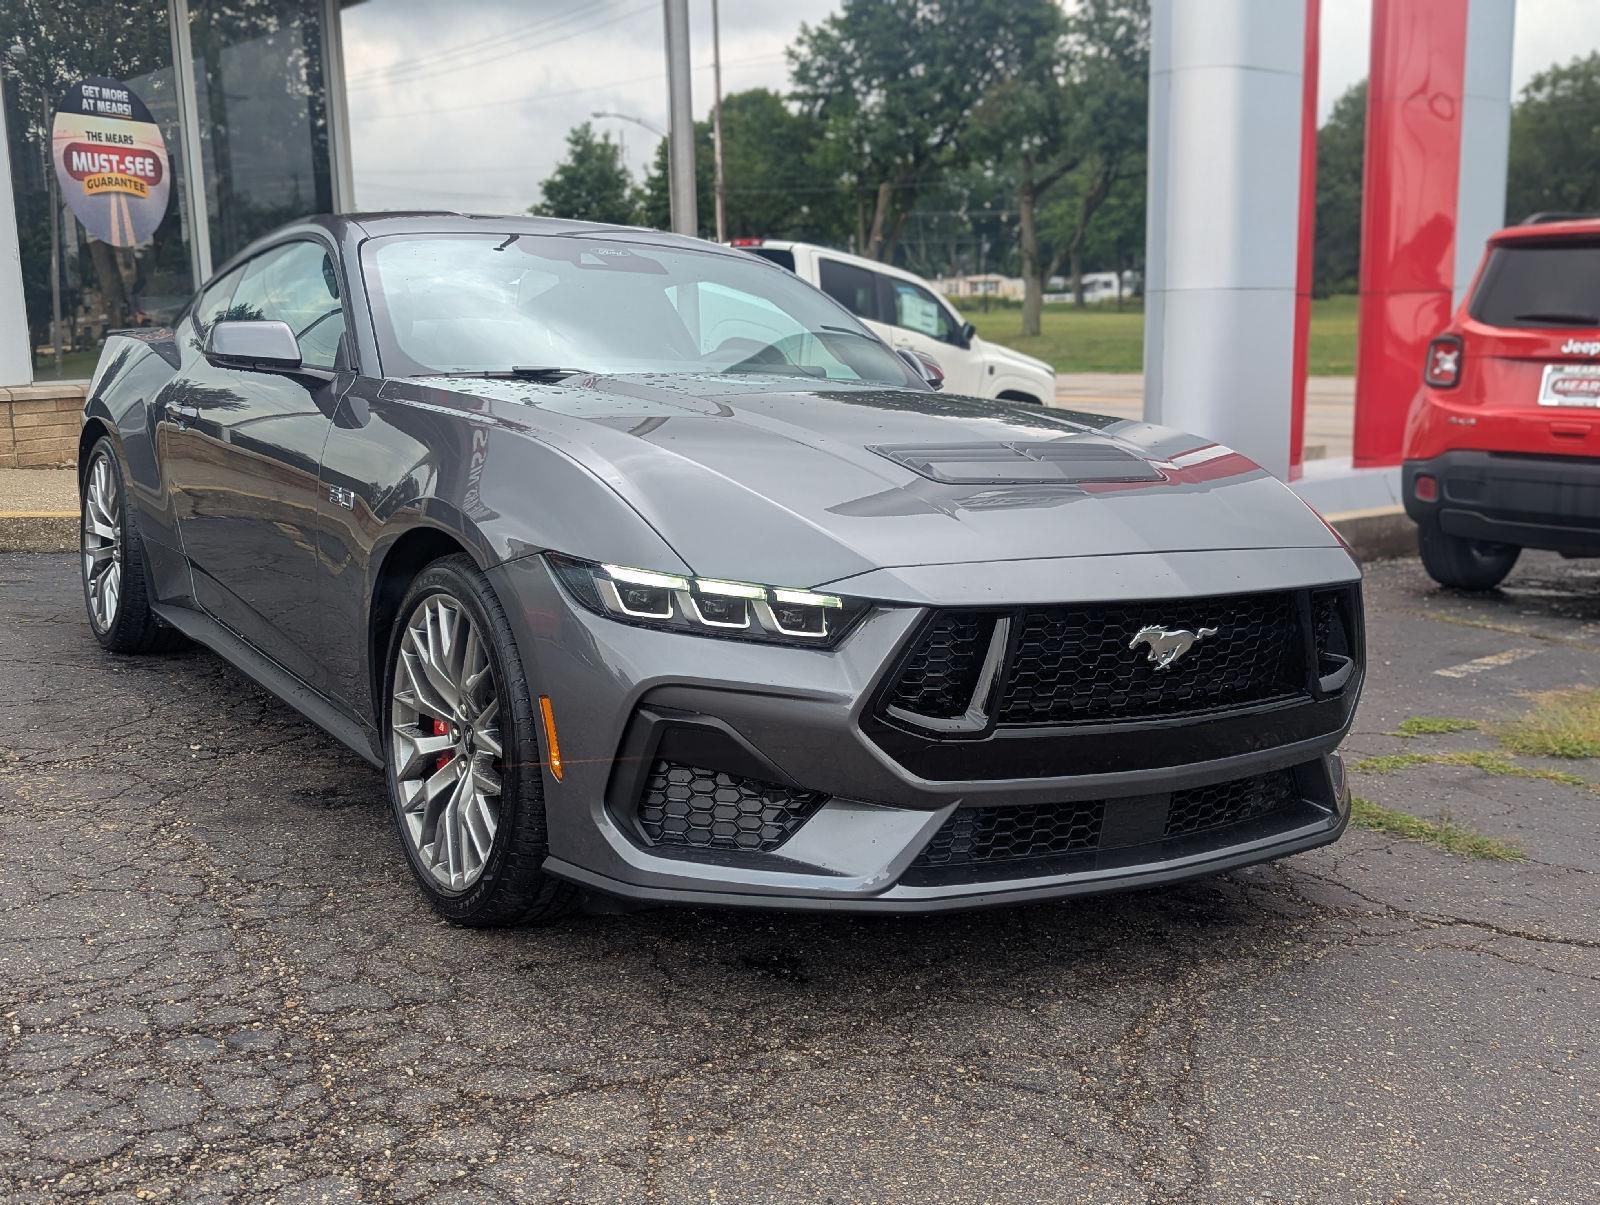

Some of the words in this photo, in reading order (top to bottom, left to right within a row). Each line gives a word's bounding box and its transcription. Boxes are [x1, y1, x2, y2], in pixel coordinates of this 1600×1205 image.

[82, 85, 100, 98] GET
[102, 88, 128, 102] MORE
[82, 99, 95, 111] AT
[97, 102, 132, 115] MEARS!
[86, 131, 103, 143] THE
[105, 134, 133, 145] MEARS
[72, 151, 154, 177] MUST-SEE
[87, 177, 145, 193] GUARANTEE
[1561, 338, 1600, 356] Jeep
[1555, 380, 1600, 393] MEAR
